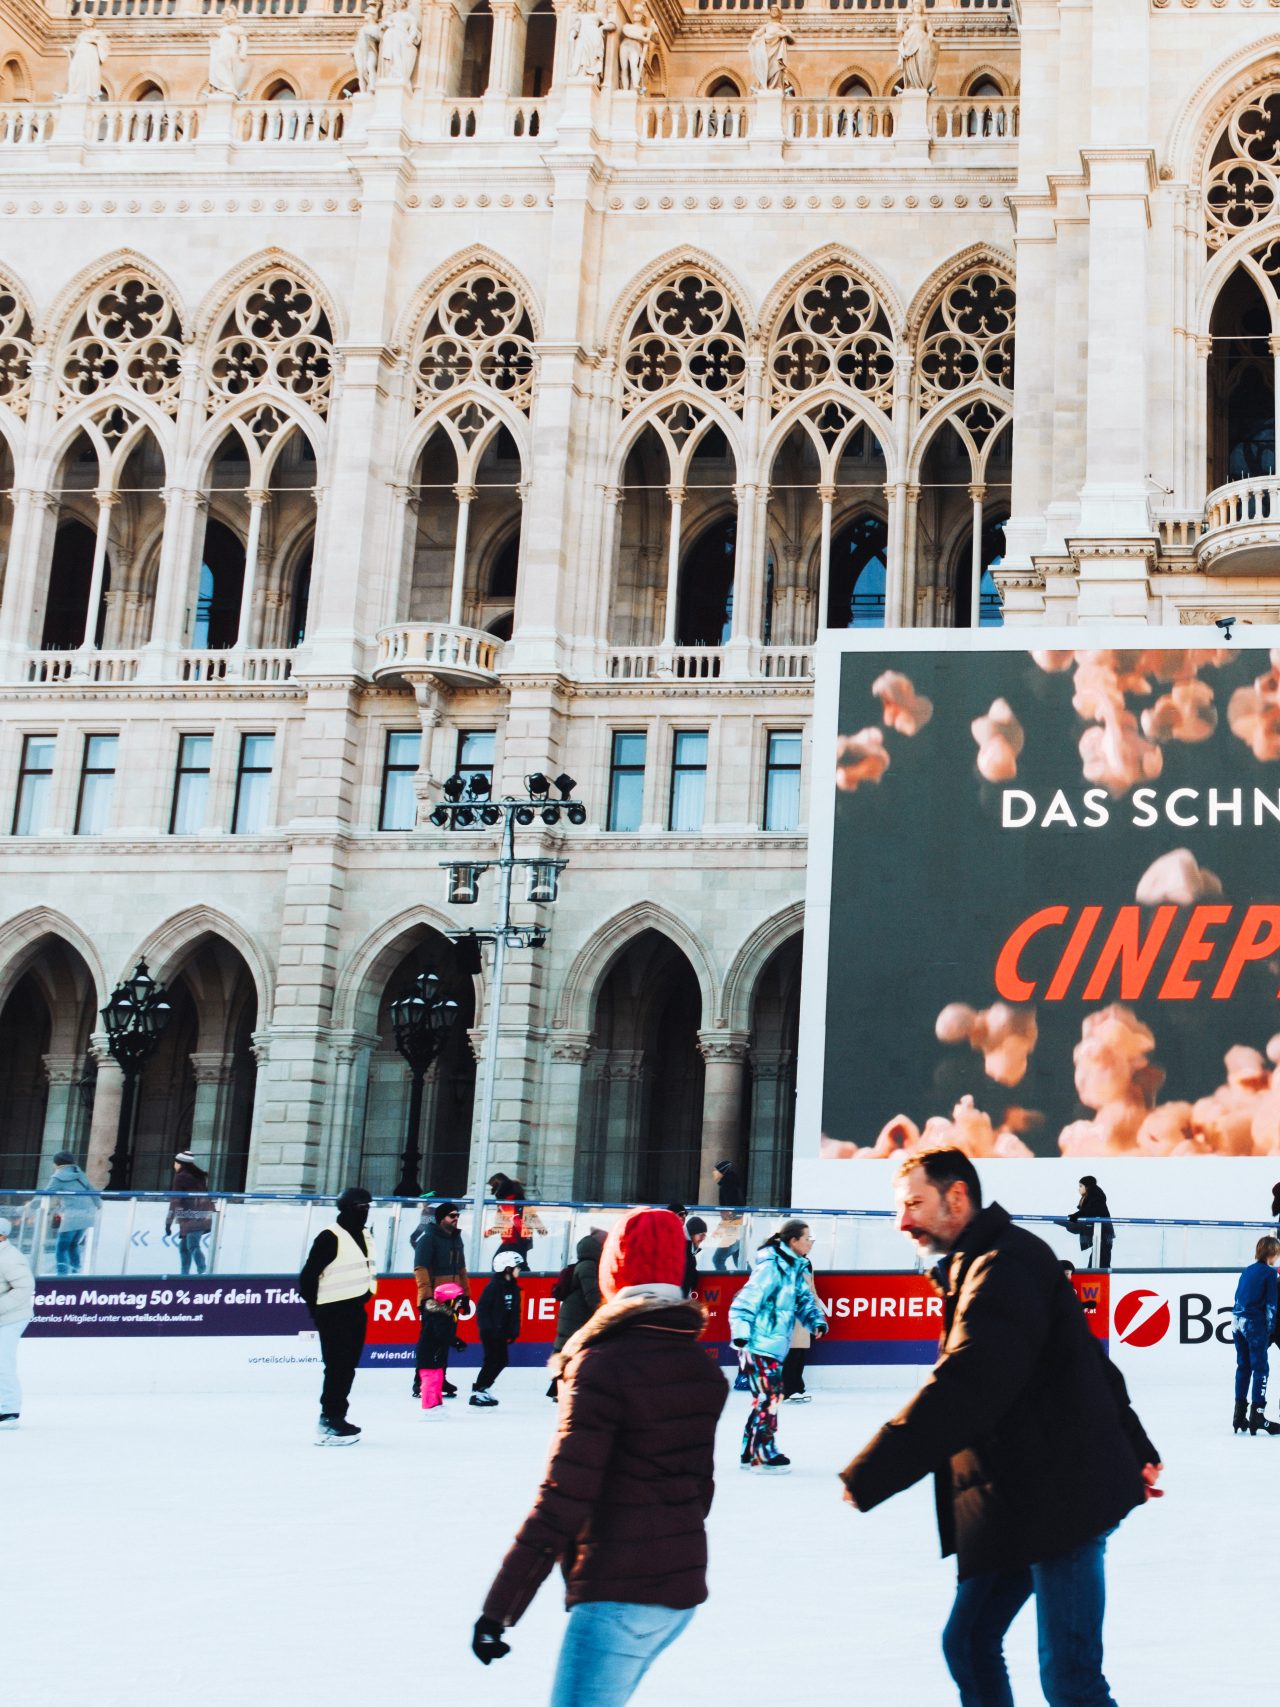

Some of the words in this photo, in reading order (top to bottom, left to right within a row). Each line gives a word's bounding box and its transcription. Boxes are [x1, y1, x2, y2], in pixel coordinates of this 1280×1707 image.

[1002, 788, 1110, 828] DAS
[80, 1289, 147, 1310] Montag
[149, 1289, 174, 1305] 50
[176, 1289, 190, 1304] %
[193, 1288, 223, 1305] auf
[224, 1288, 262, 1305] dein
[818, 1296, 943, 1318] NSPIRIER
[29, 1314, 62, 1323] ostenlos
[63, 1314, 98, 1325] Mitglied
[121, 1312, 204, 1322] vorteilsclub.wien.at
[248, 1355, 325, 1364] vorteilsclub.wien.
[370, 1350, 417, 1360] #wiendri
